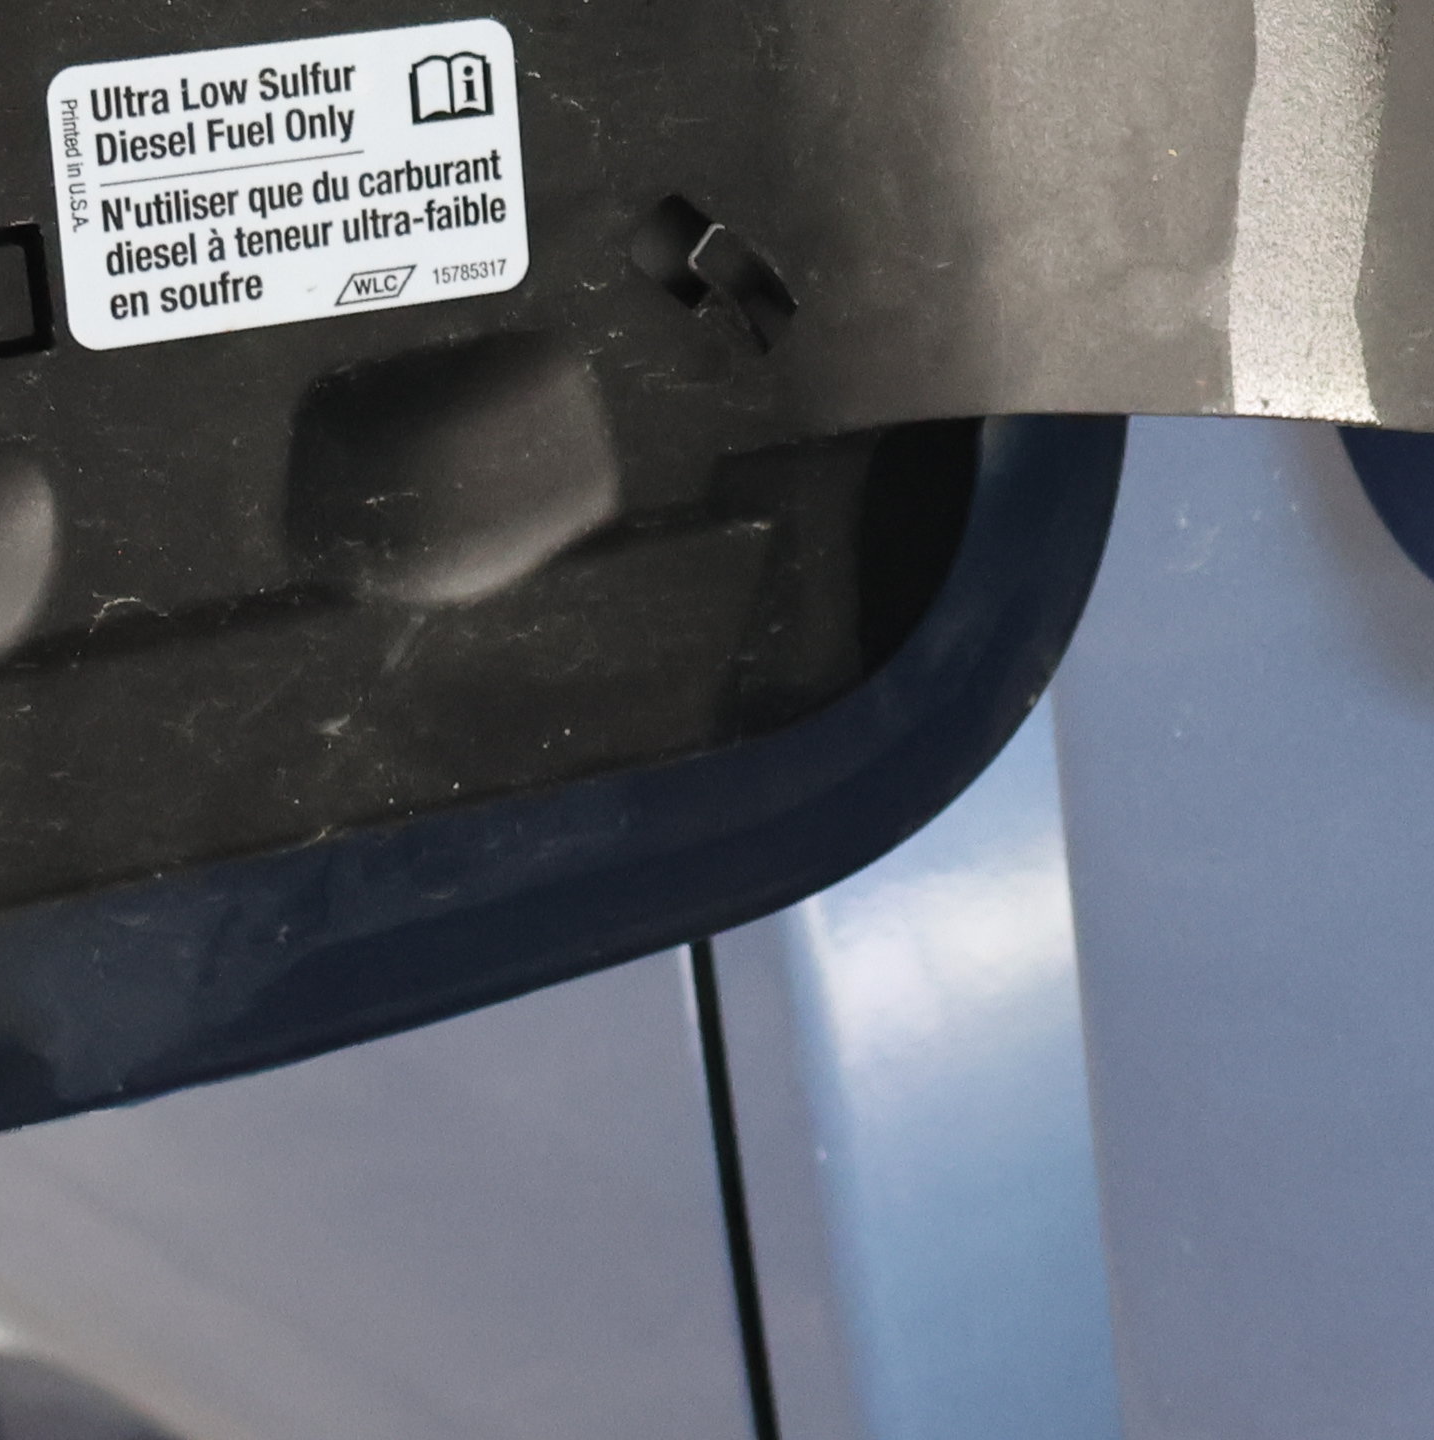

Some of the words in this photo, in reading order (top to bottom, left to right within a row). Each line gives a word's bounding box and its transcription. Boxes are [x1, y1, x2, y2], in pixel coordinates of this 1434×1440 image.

[91, 82, 170, 122] Ultra
[182, 76, 248, 111] Low
[259, 61, 356, 102] Sulfur
[61, 99, 81, 158] Printed
[96, 123, 195, 167] Diesel
[208, 113, 274, 152] Fuel
[286, 106, 354, 143] Only
[67, 163, 81, 178] in
[102, 185, 238, 232] N'utiliser
[249, 179, 303, 219] que
[313, 170, 349, 203] du
[359, 149, 501, 196] carburant
[69, 182, 89, 233] U.S.A.
[106, 232, 196, 277] diesel
[208, 227, 226, 262] à
[235, 219, 332, 259] teneur
[342, 193, 507, 243] ultra-faible
[110, 292, 148, 320] en
[160, 270, 263, 312] soufre
[353, 274, 398, 297] WLC
[433, 259, 507, 285] 15785317
